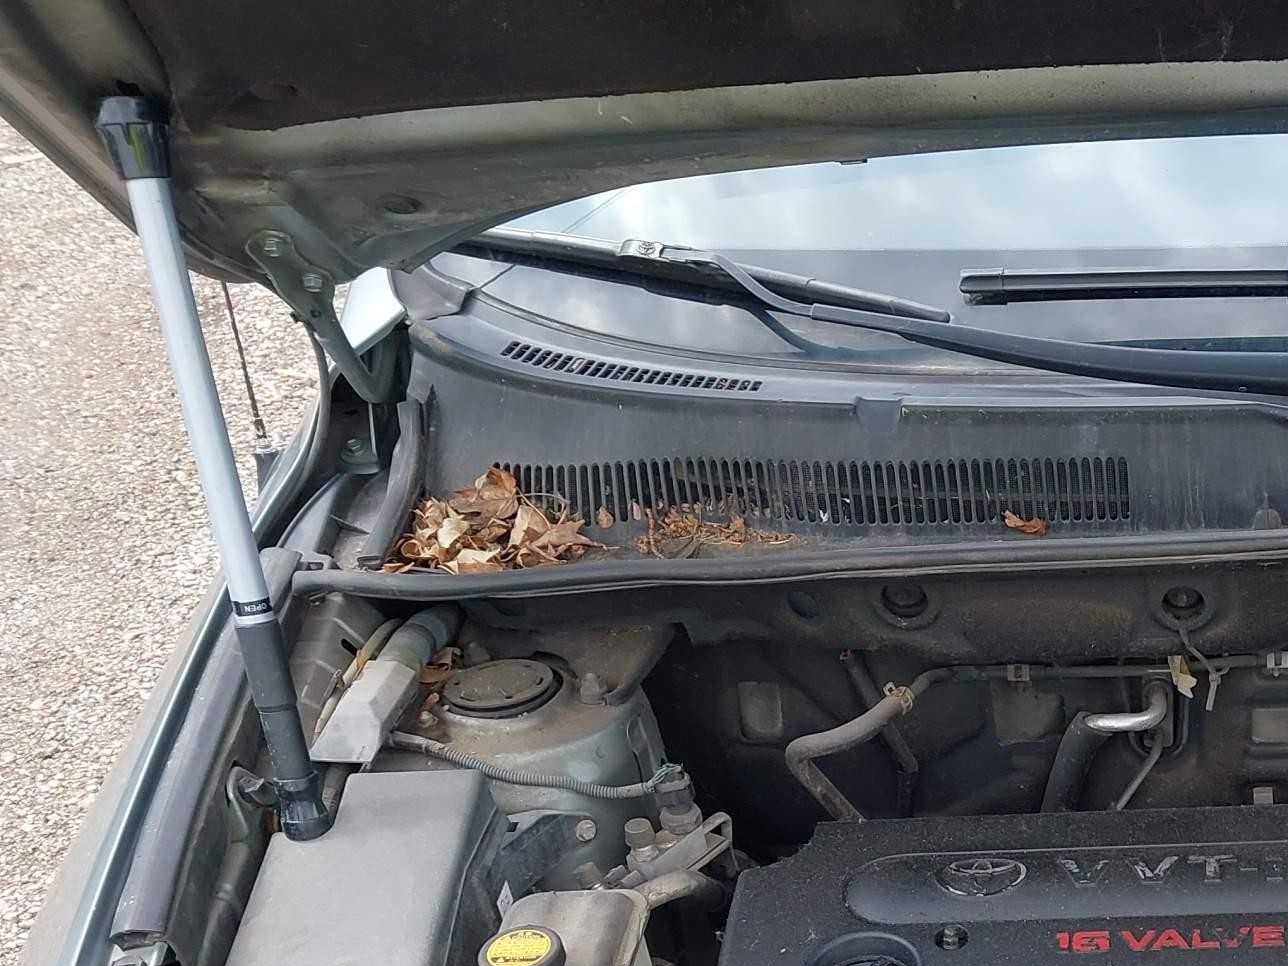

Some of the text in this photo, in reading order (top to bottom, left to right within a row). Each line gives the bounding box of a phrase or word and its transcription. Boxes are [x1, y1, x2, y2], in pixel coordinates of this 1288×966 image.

[244, 603, 267, 612] OPEN
[1056, 925, 1286, 953] 16 VALVE
